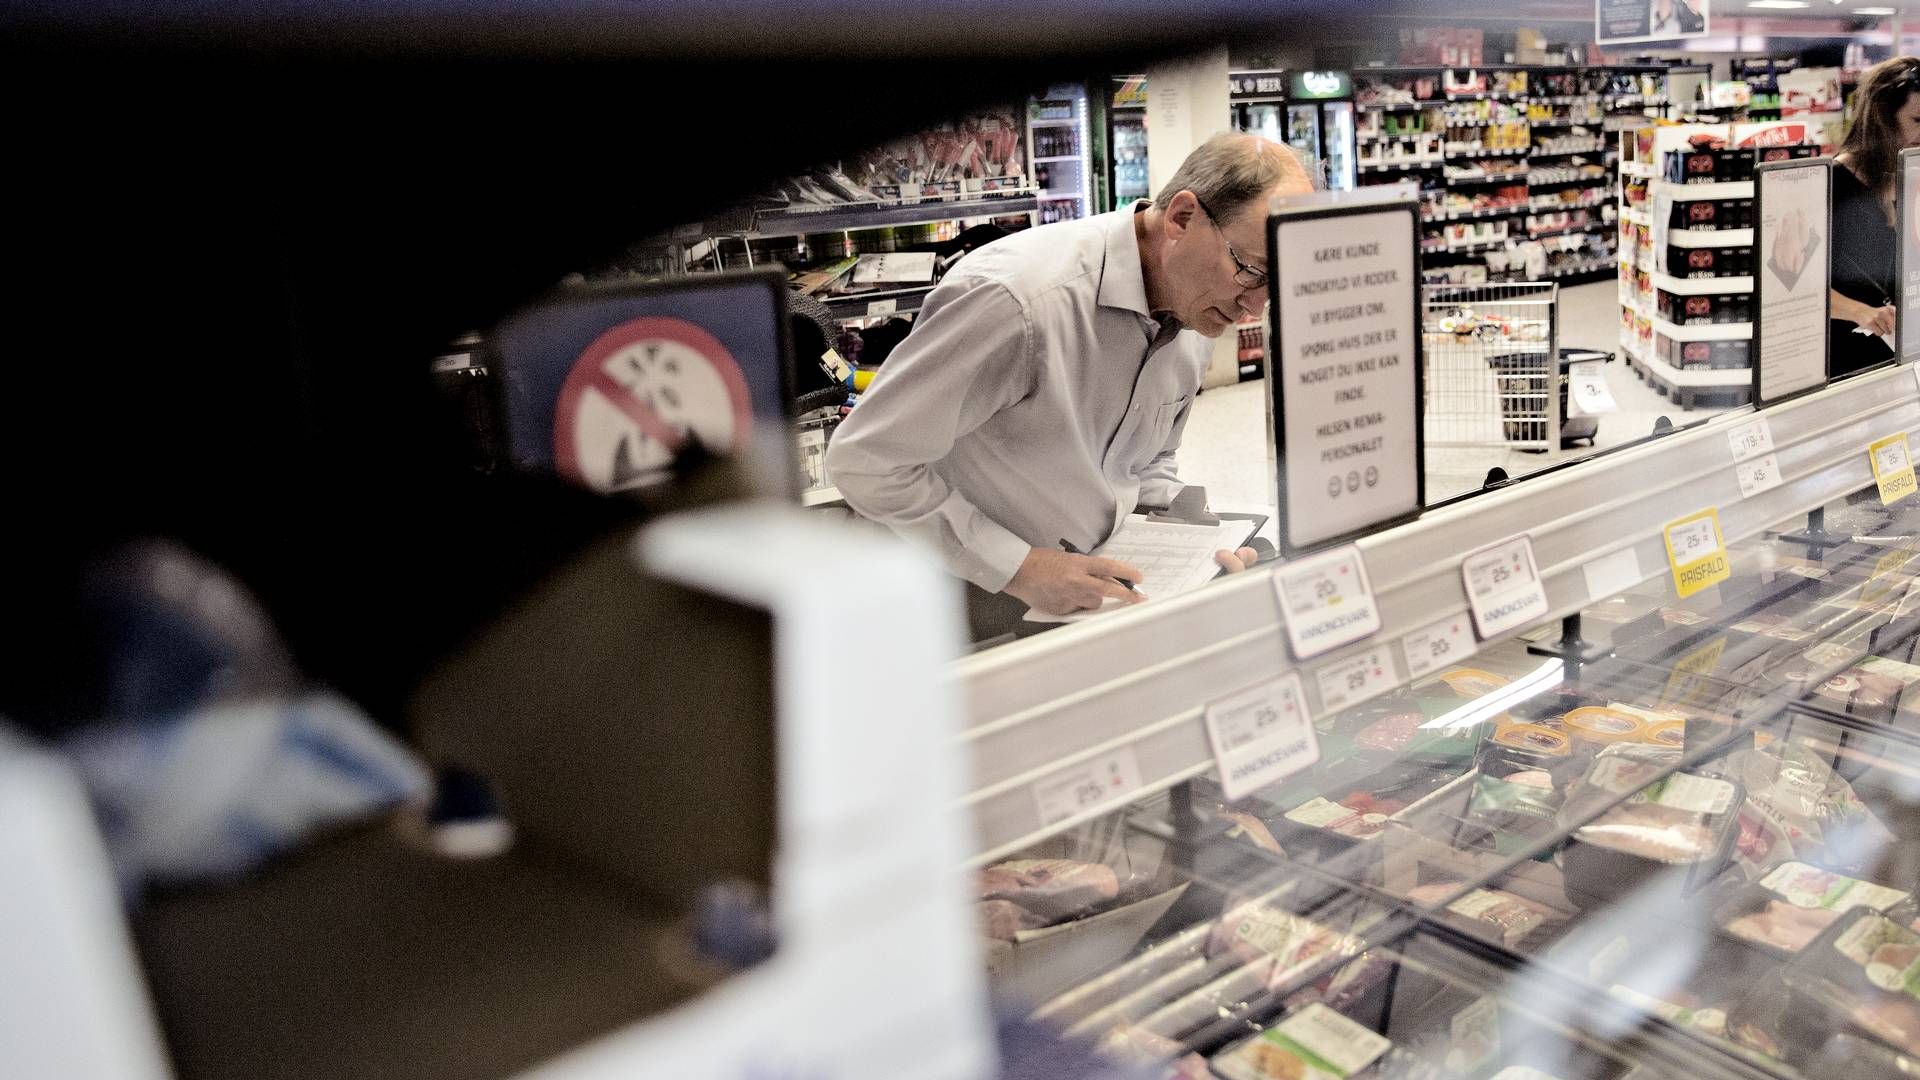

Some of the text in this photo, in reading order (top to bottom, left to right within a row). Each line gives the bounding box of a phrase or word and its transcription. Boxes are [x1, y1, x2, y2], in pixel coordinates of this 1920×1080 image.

[1256, 77, 1282, 93] BEER
[1313, 242, 1381, 263] KÆRE KUNDE
[1293, 277, 1348, 297] UNDSKYLD
[1350, 274, 1361, 289] VI
[1310, 312, 1321, 325] VI
[1324, 304, 1362, 323] BYGGER
[1300, 328, 1397, 358] SPØRG HVIS DER ER
[1300, 365, 1334, 384] NOGET
[1337, 363, 1351, 378] DU
[1379, 355, 1399, 369] KAN
[1316, 419, 1351, 439] HILSEN
[1321, 436, 1383, 462] PERSONALET
[1883, 473, 1914, 494] PRISFALD
[1680, 557, 1725, 587] PRISFALD
